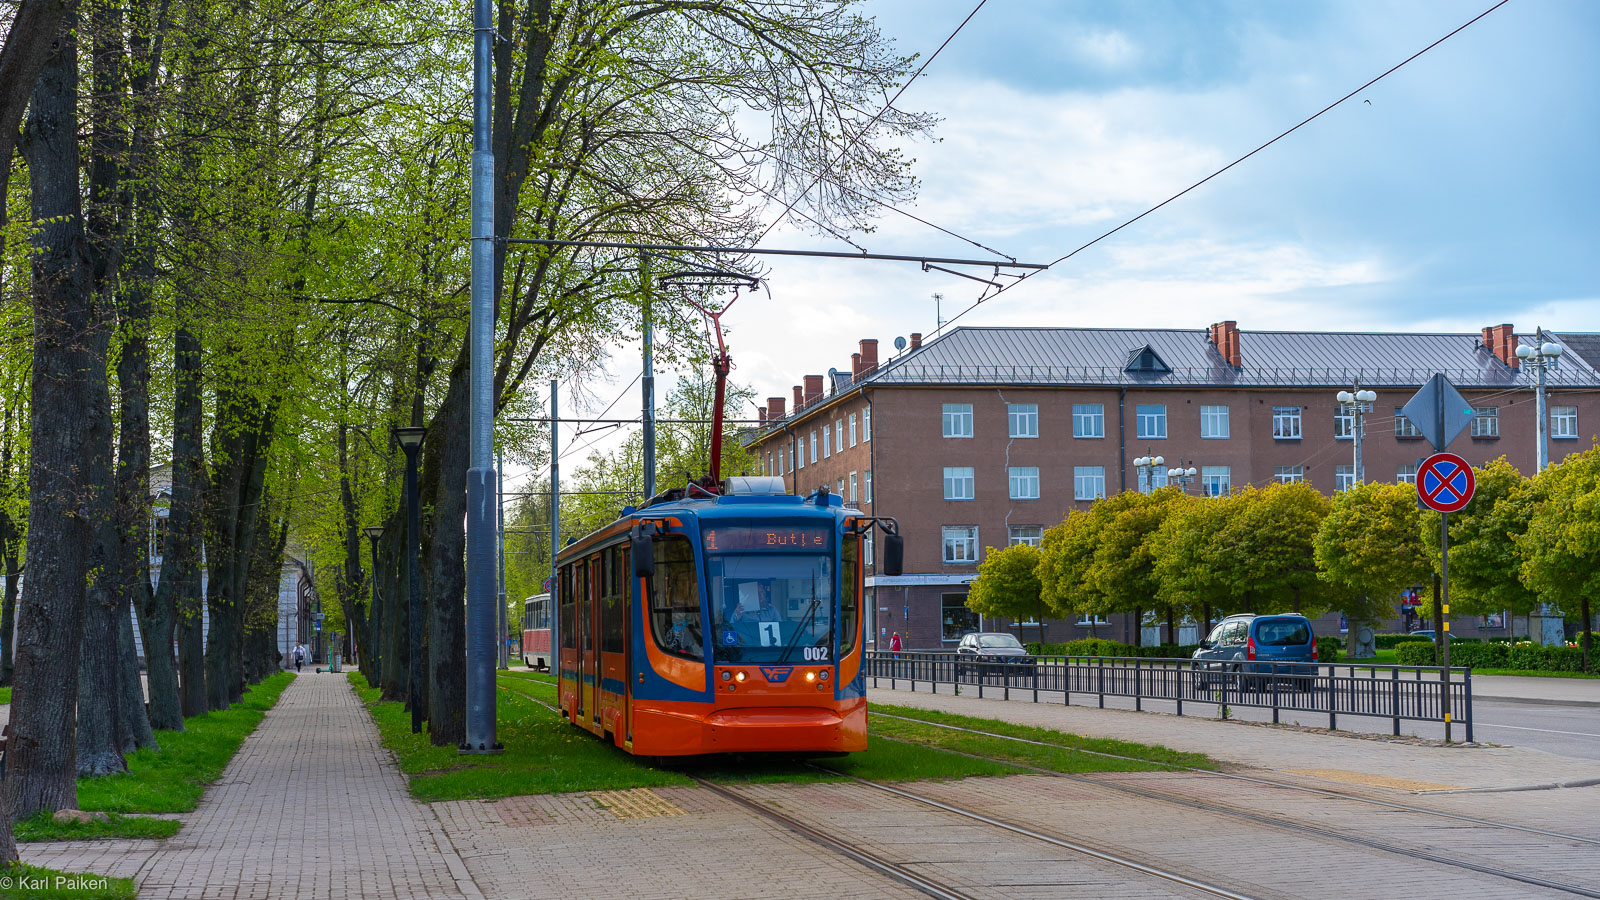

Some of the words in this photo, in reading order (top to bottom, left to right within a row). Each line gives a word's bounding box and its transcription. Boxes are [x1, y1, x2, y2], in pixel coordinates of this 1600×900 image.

[706, 530, 718, 549] 1
[764, 624, 777, 646] 1
[803, 646, 828, 661] 002
